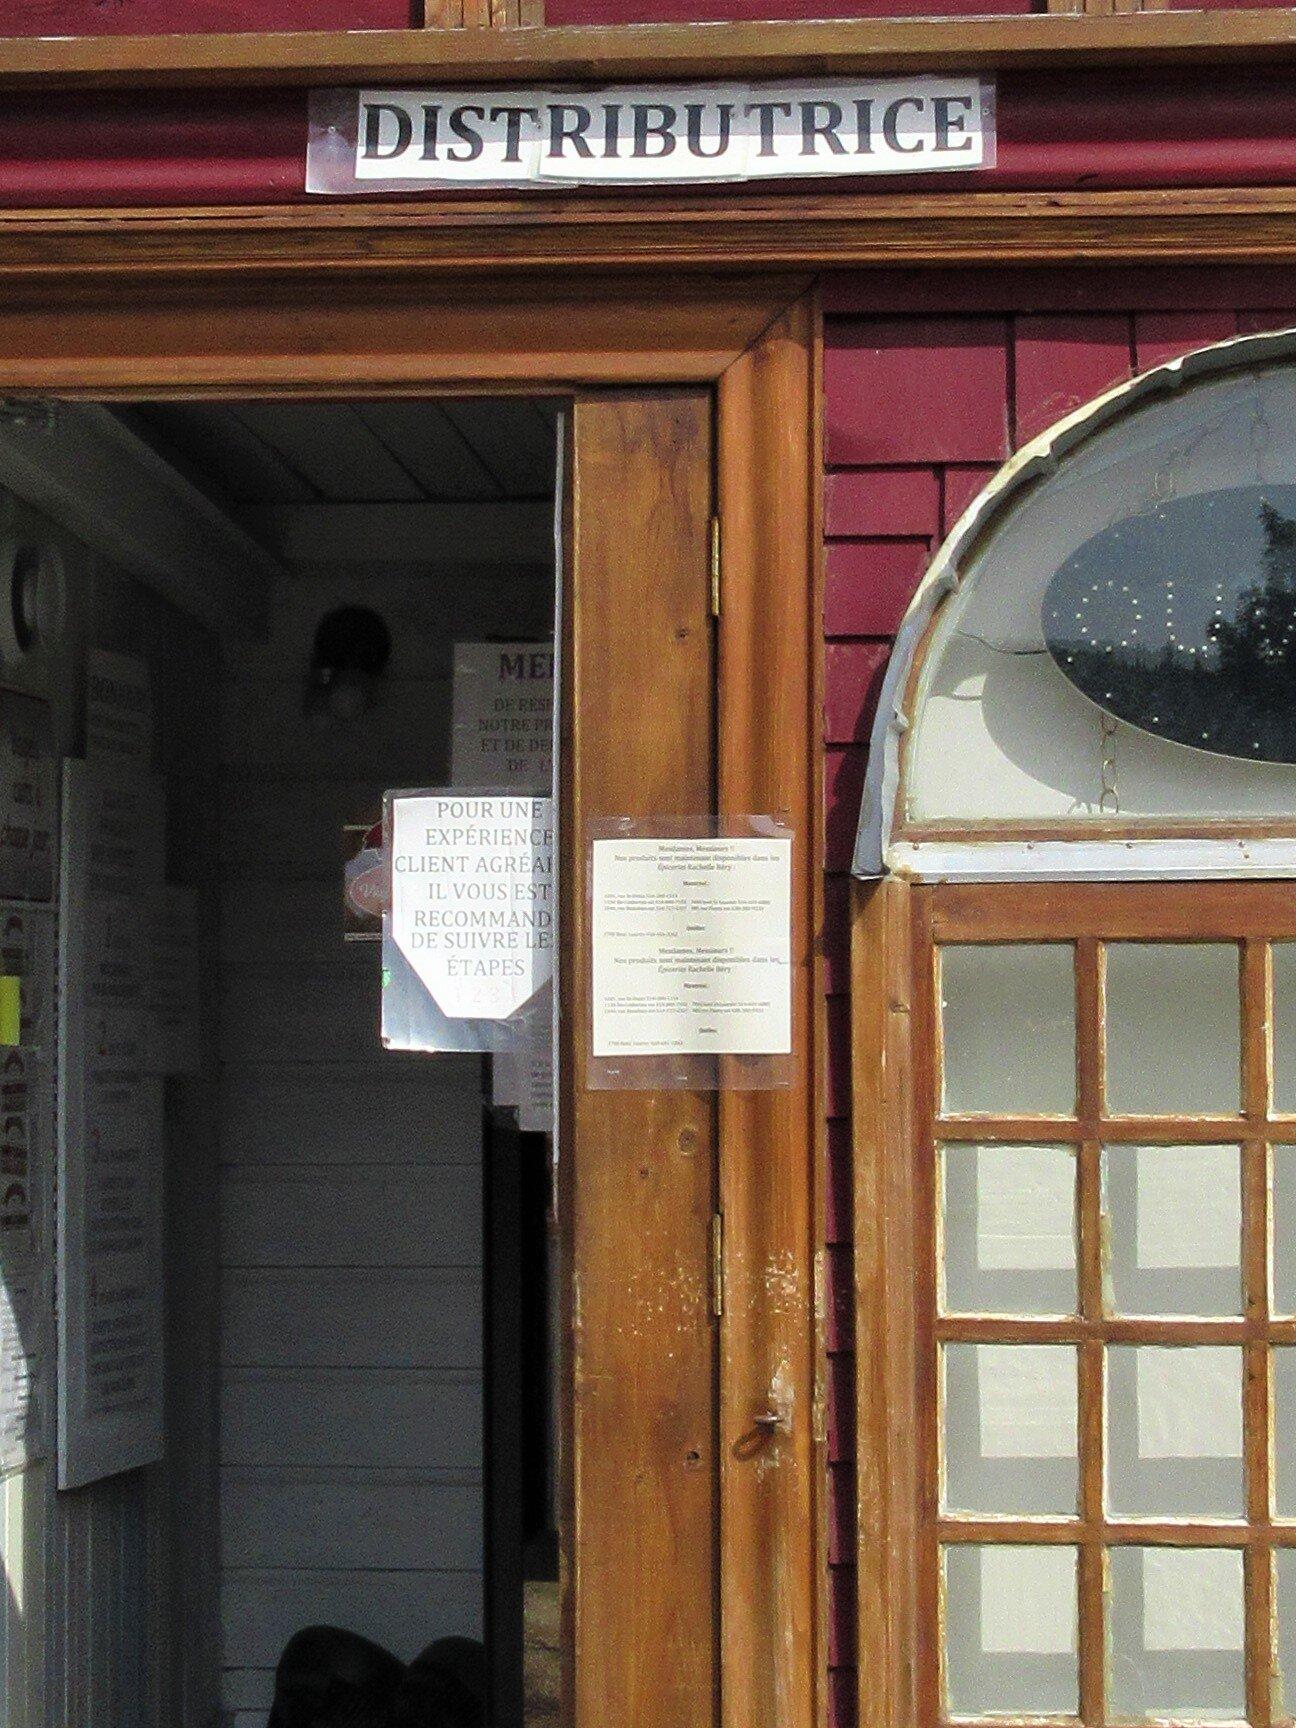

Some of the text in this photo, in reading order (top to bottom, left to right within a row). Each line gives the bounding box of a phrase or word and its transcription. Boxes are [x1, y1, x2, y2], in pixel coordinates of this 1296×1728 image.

[360, 95, 974, 163] DISTRIBUTRICE
[478, 718, 530, 732] NOTRE
[437, 801, 544, 819] POUR UNE
[425, 824, 553, 847] EXPÉRIENCE
[394, 855, 469, 874] CLIENT
[428, 882, 552, 900] IL VOUS EST
[411, 931, 438, 949] DE
[444, 931, 519, 949] SUIVRE
[447, 954, 526, 977] ÉTAPES
